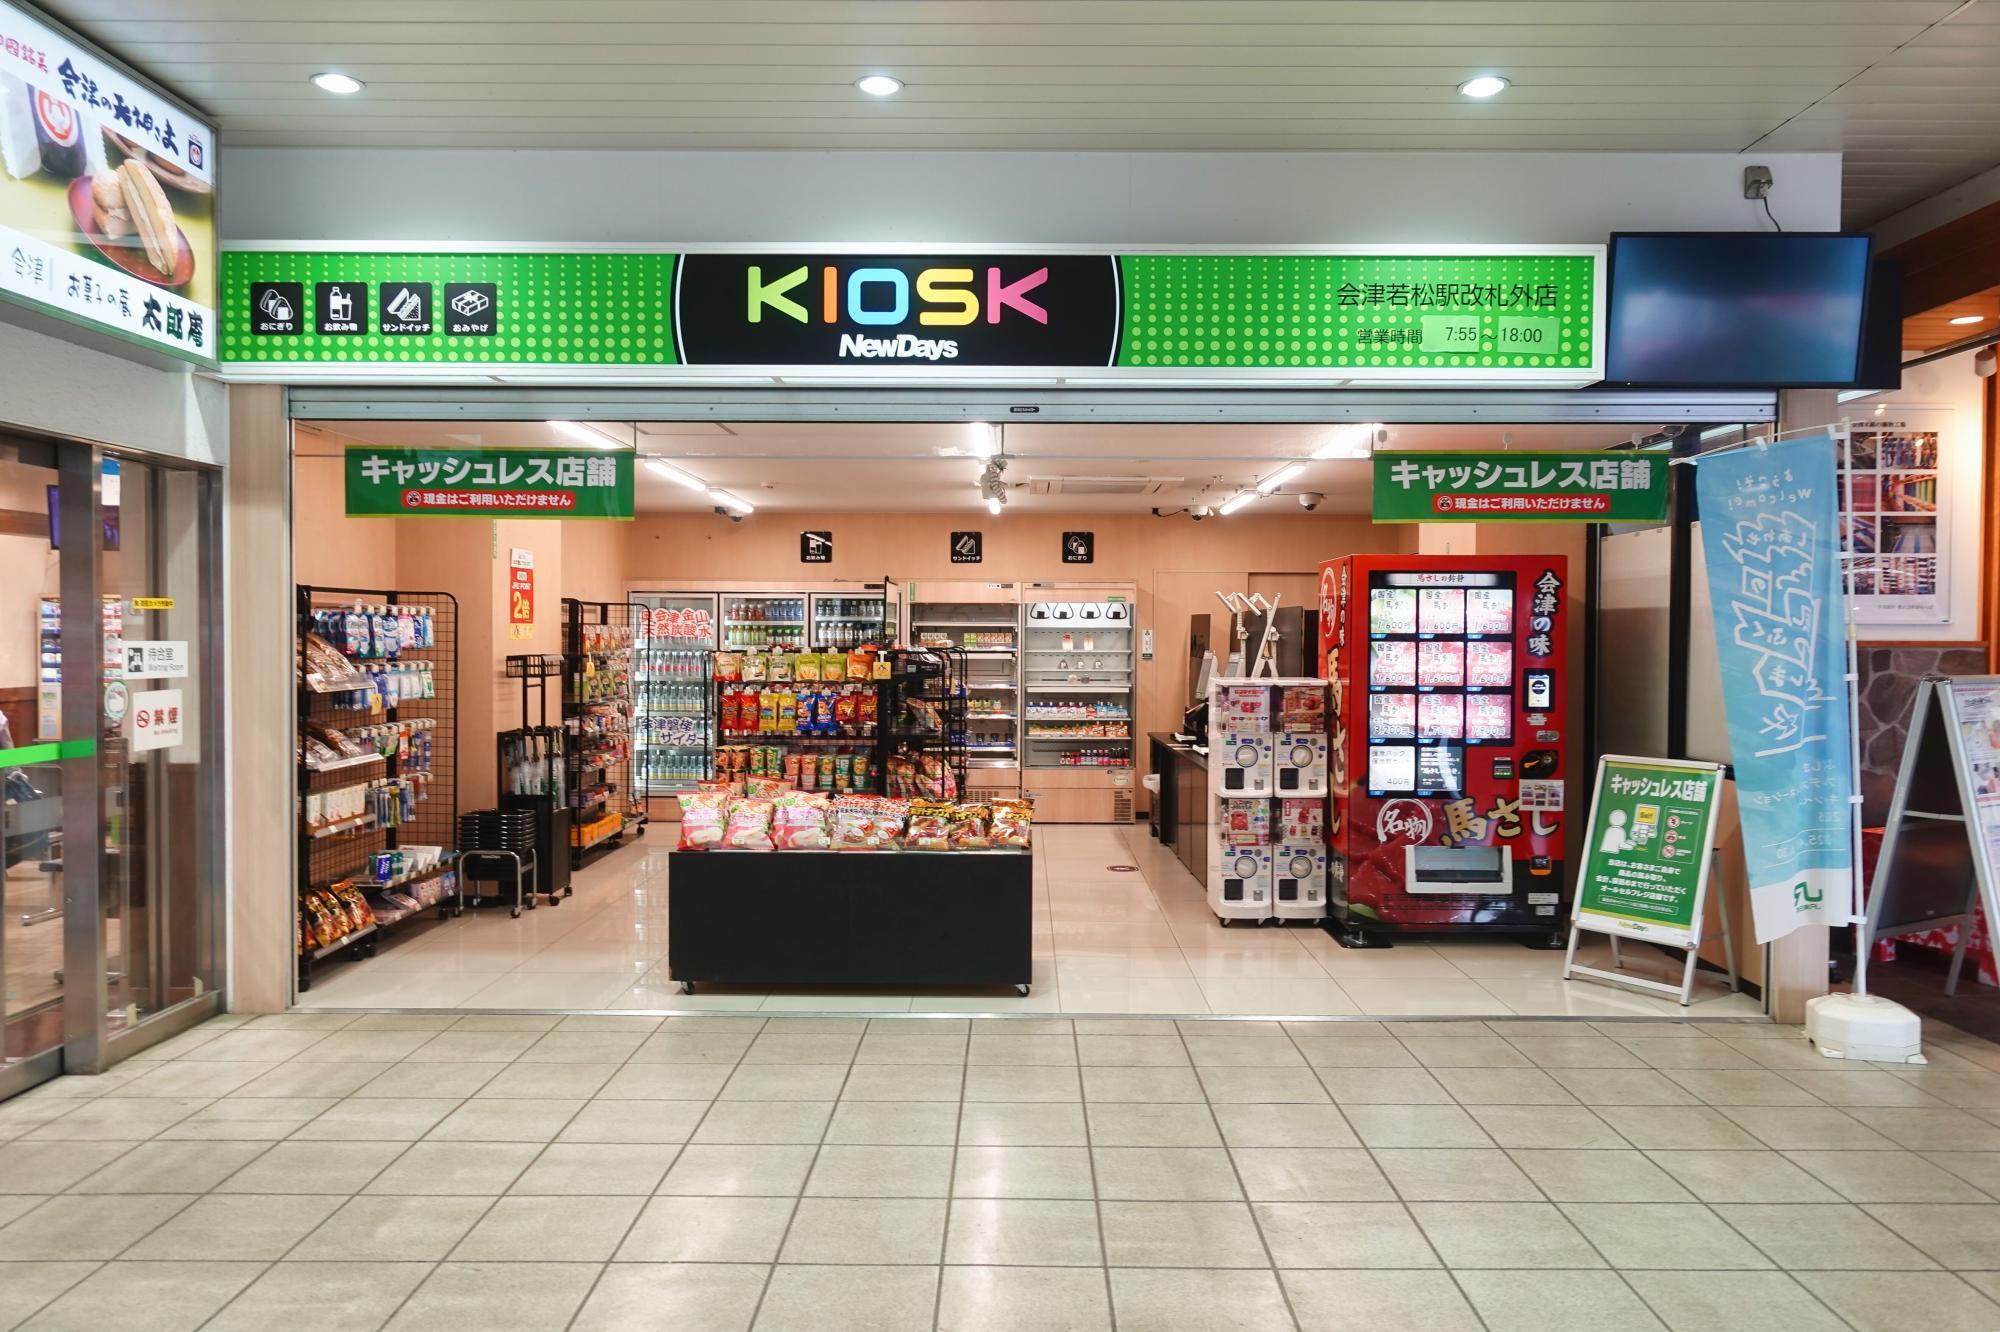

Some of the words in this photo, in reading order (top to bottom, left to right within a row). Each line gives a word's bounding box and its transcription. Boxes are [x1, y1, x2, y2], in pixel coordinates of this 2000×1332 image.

[747, 266, 1048, 326] KIOSK
[1336, 282, 1559, 307] 会津若松駅改札外店
[260, 322, 294, 331] おにぎり
[324, 322, 358, 331] お飲み物
[382, 323, 431, 332] サンドイッチ
[452, 323, 488, 332] おみやげ
[1356, 328, 1423, 345] 営業時間
[838, 334, 959, 360] NewDays
[361, 454, 617, 488] キャッシュレス店舗
[1391, 459, 1651, 490] キャッシュレス店舗
[423, 491, 571, 508] 現金はご利用いただけません
[1454, 497, 1606, 510] 現金はご利用いただけません
[513, 591, 530, 619] 2倍
[1527, 570, 1561, 657] 会津の味
[642, 623, 712, 637] 天然炭酸水
[148, 647, 174, 661] 待合室
[153, 707, 179, 726] 禁煙
[1611, 773, 1708, 803] キャッシュレス店舗
[1384, 808, 1428, 840] 名物
[1441, 797, 1559, 848] 馬さし
